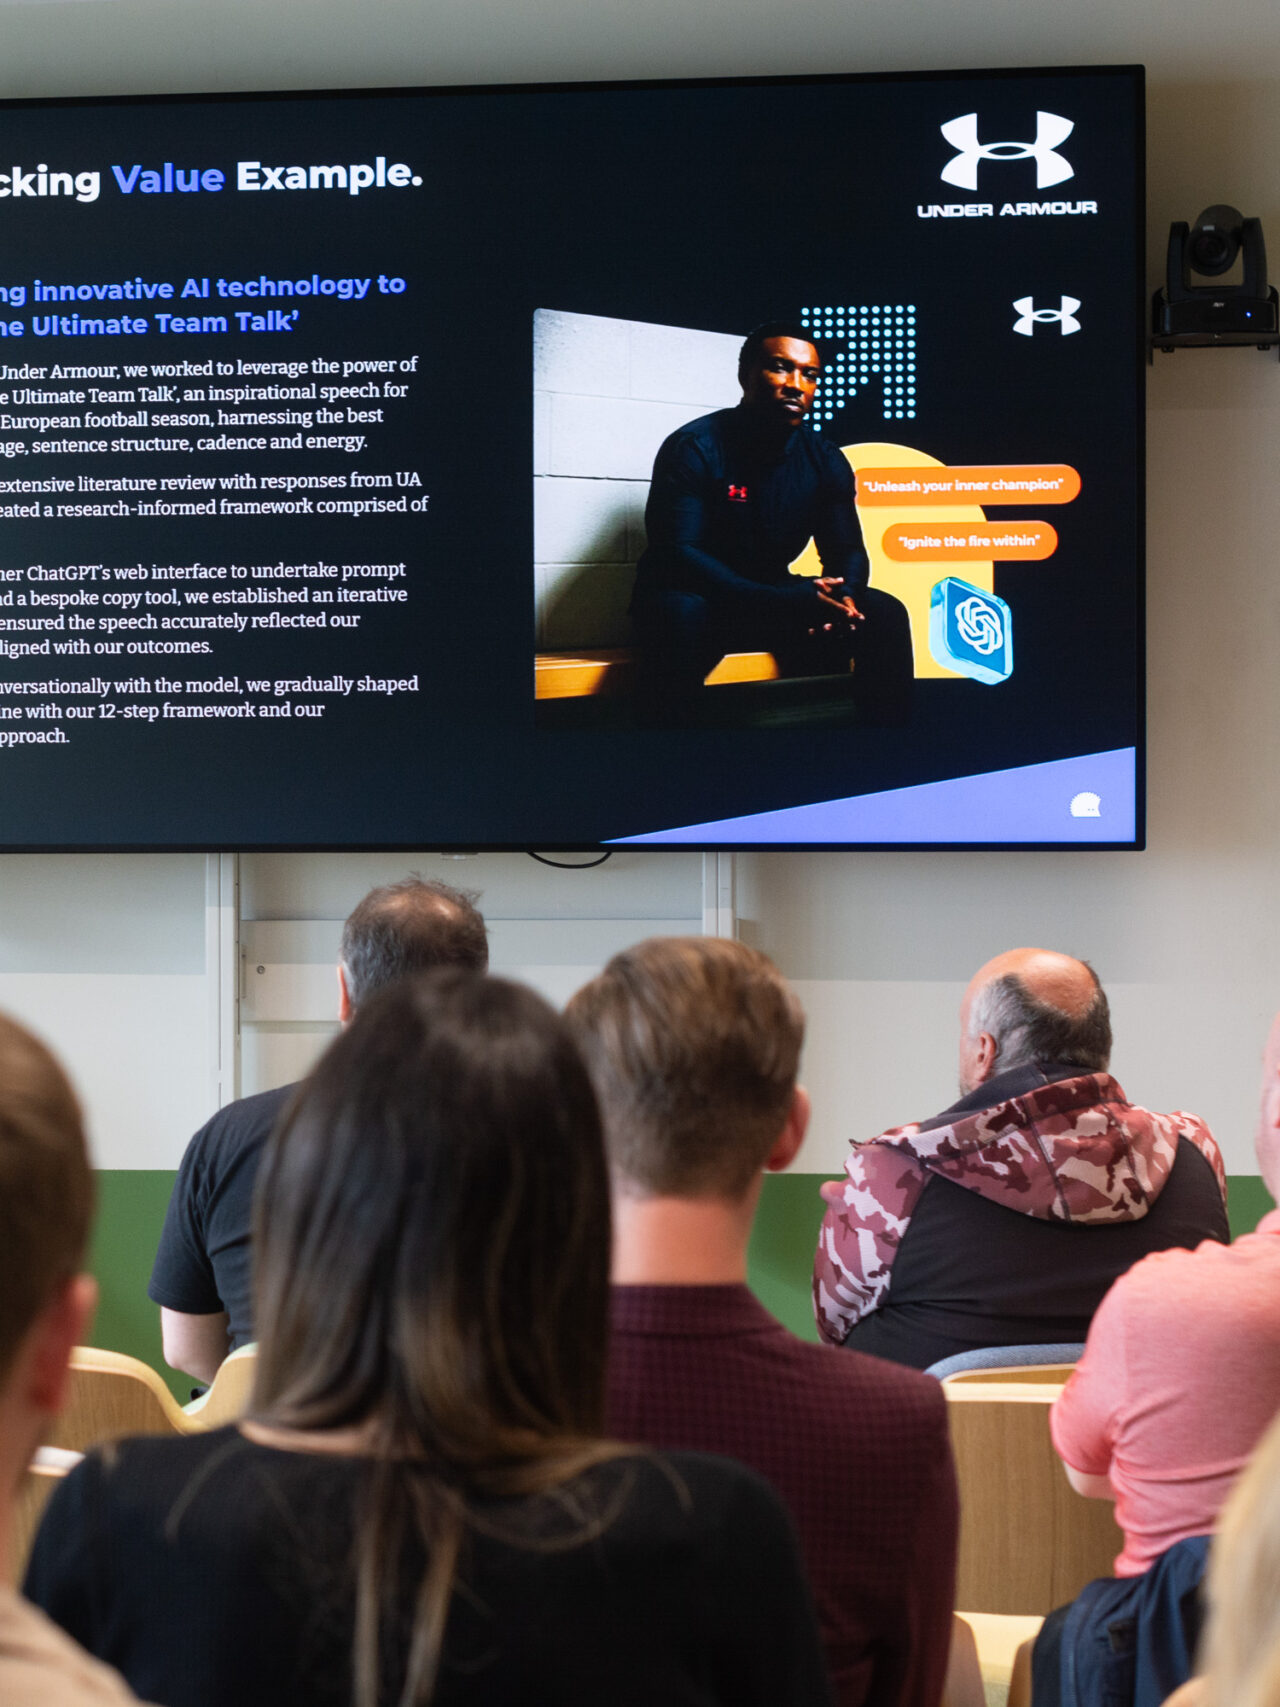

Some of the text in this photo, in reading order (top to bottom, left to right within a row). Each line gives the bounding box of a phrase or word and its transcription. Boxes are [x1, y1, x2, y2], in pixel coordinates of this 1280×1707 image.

[111, 162, 226, 193] Value
[237, 156, 422, 195] Example.
[917, 201, 1098, 218] UNDER ARMOUR
[33, 277, 174, 301] innovative
[180, 278, 209, 298] AI
[216, 274, 371, 299] technology
[377, 274, 407, 293] to
[32, 313, 149, 336] Ultimate
[154, 313, 228, 333] Team
[49, 364, 120, 379] Armour,
[123, 365, 147, 377] we
[150, 360, 213, 376] worked
[216, 362, 233, 375] to
[237, 359, 308, 378] leverage
[311, 357, 340, 373] the
[342, 360, 397, 377] power
[399, 355, 418, 371] of
[12, 388, 85, 404] Ultimate
[88, 388, 135, 402] Team
[183, 389, 205, 401] an
[208, 383, 316, 404] inspirational
[320, 382, 380, 402] speech
[383, 381, 408, 397] for
[0, 414, 81, 432] European
[84, 411, 148, 427] football
[151, 414, 214, 427] season,
[217, 408, 313, 428] harnessing
[315, 407, 344, 423] the
[347, 407, 383, 423] best
[32, 439, 107, 453] sentence
[111, 437, 193, 452] structure,
[197, 434, 266, 450] cadence
[270, 433, 302, 449] and
[306, 436, 367, 452] energy.
[78, 476, 157, 491] literature
[160, 474, 216, 490] review
[218, 473, 257, 489] with
[260, 476, 347, 492] responses
[350, 471, 392, 487] from
[396, 472, 422, 486] UA
[922, 482, 953, 494] your
[955, 479, 990, 490] inner
[43, 505, 53, 517] a
[57, 499, 216, 516] research-informed
[220, 497, 313, 514] framework
[316, 496, 407, 516] comprised
[410, 495, 429, 511] of
[943, 536, 966, 547] the
[968, 535, 991, 546] fire
[113, 564, 148, 579] web
[151, 563, 227, 579] interface
[230, 565, 247, 578] to
[251, 561, 338, 578] undertake
[342, 563, 406, 581] prompt
[17, 594, 27, 605] a
[29, 589, 99, 609] bespoke
[102, 593, 142, 608] copy
[144, 588, 181, 606] tool,
[184, 592, 209, 604] we
[212, 587, 308, 603] established
[312, 591, 333, 602] an
[337, 586, 407, 602] iterative
[68, 614, 95, 629] the
[99, 613, 158, 633] speech
[161, 612, 248, 632] accurately
[251, 611, 326, 627] reflected
[330, 615, 360, 627] our
[53, 639, 91, 654] with
[94, 642, 124, 654] our
[127, 640, 213, 653] outcomes.
[113, 677, 151, 693] with
[154, 677, 182, 692] the
[185, 676, 243, 694] model,
[246, 680, 270, 692] we
[274, 675, 354, 696] gradually
[357, 675, 419, 695] shaped
[25, 703, 63, 718] with
[66, 707, 95, 718] our
[98, 703, 159, 722] 12-step
[162, 701, 256, 717] framework
[259, 701, 291, 717] and
[294, 705, 325, 716] our
